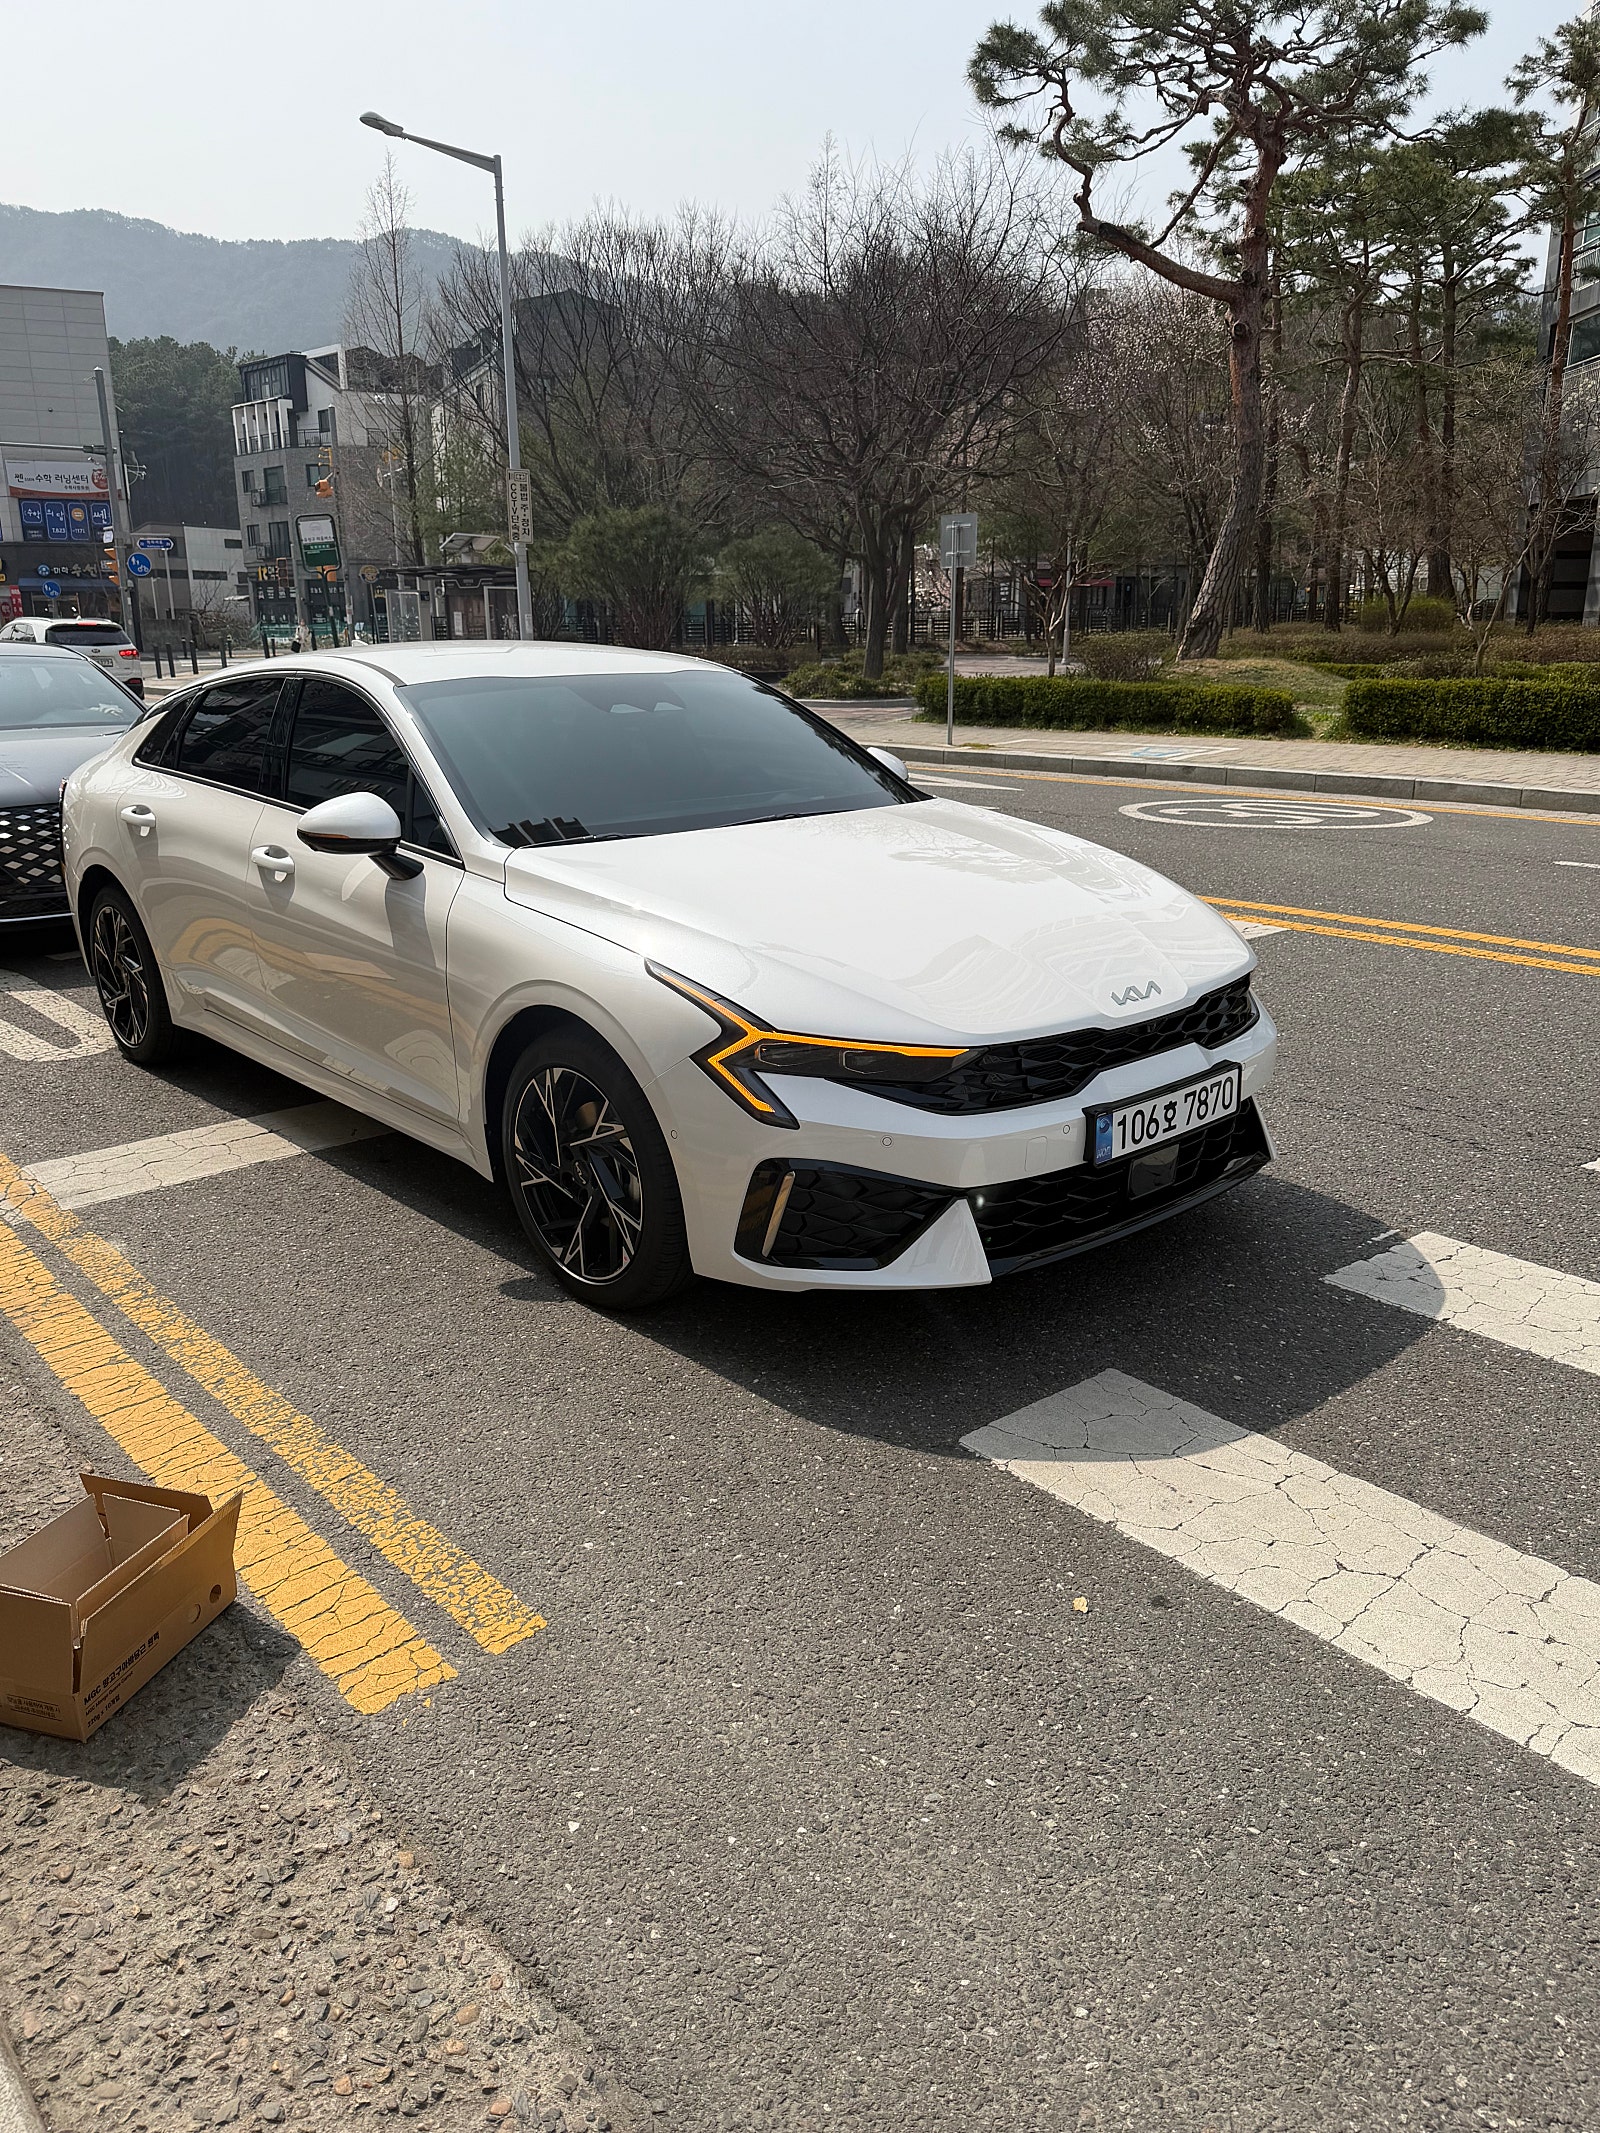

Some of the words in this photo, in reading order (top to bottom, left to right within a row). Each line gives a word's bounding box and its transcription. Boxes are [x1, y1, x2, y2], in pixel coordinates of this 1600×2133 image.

[35, 474, 52, 484] 수학
[54, 474, 89, 485] 러닝센터
[1117, 1099, 1178, 1150] 106호
[1184, 1076, 1234, 1126] 7870
